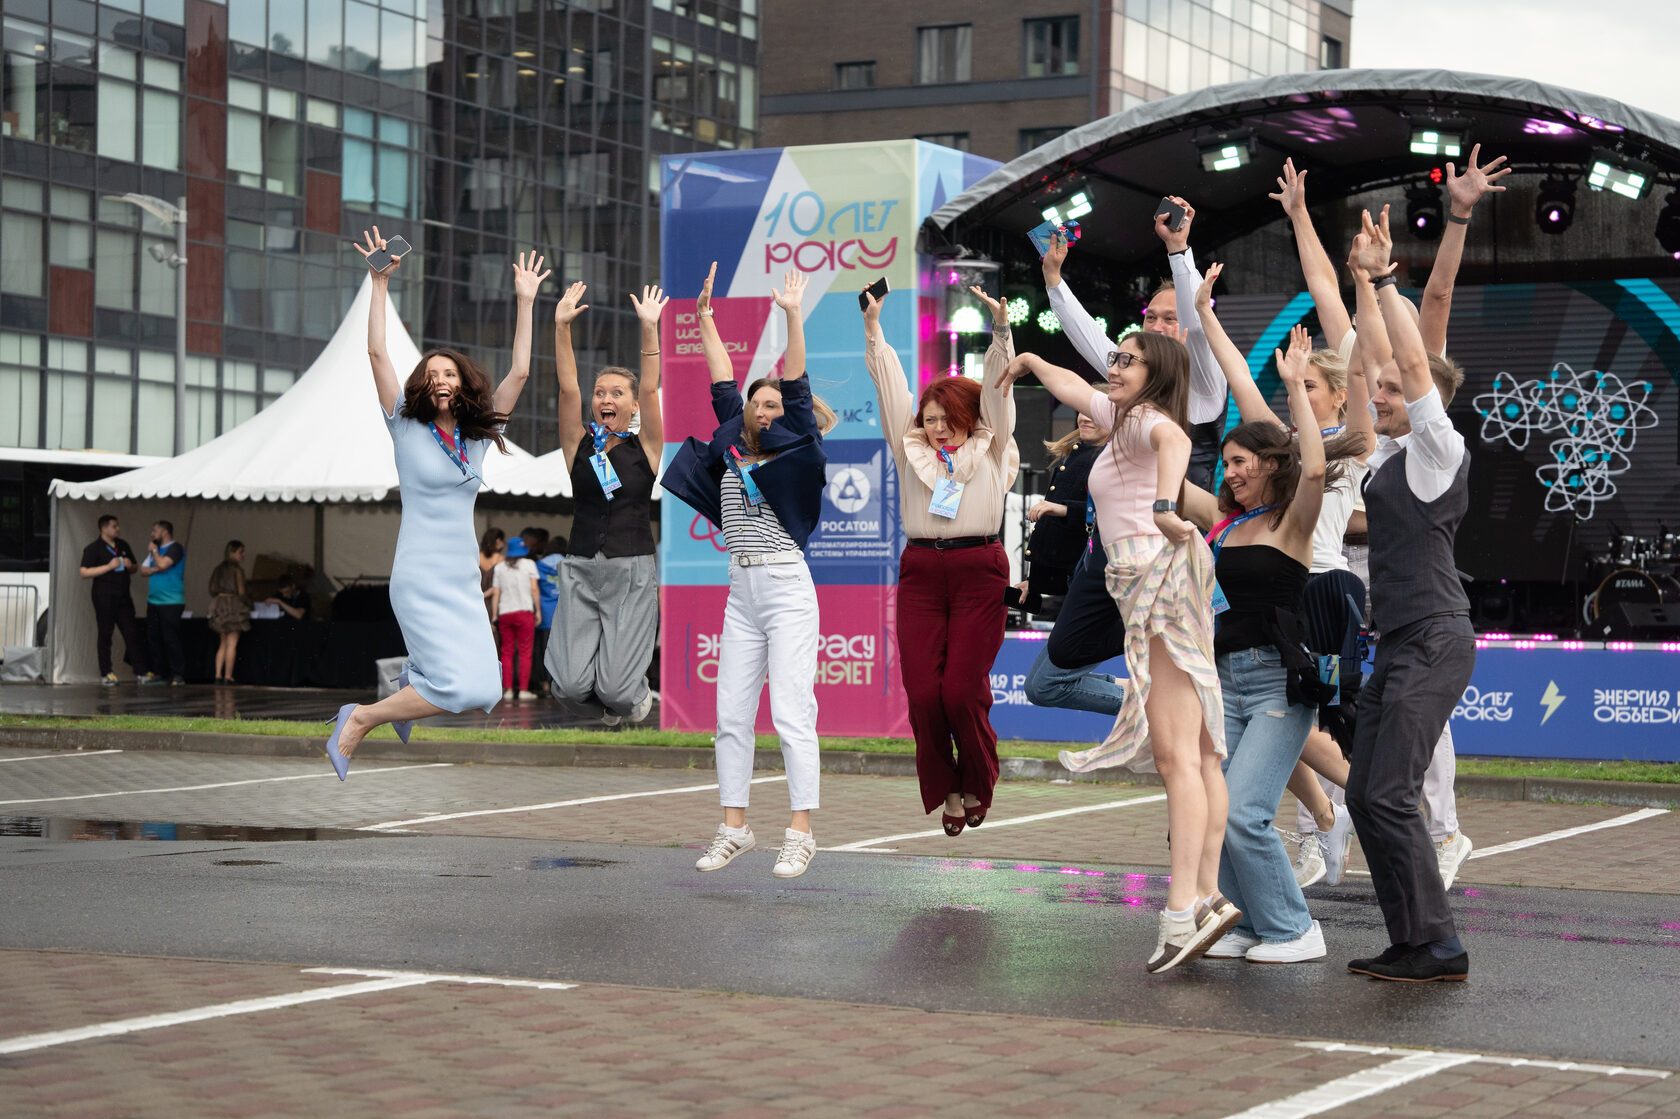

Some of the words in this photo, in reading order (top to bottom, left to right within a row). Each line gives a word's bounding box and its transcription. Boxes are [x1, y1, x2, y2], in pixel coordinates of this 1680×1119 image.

[764, 190, 825, 238] 10
[827, 199, 899, 235] ЛЕТ
[821, 520, 880, 532] РОСАТОМ
[1461, 685, 1480, 706] 0
[1479, 691, 1514, 706] ЛЕТ
[1593, 688, 1671, 707] ЭНЕРГИЯ
